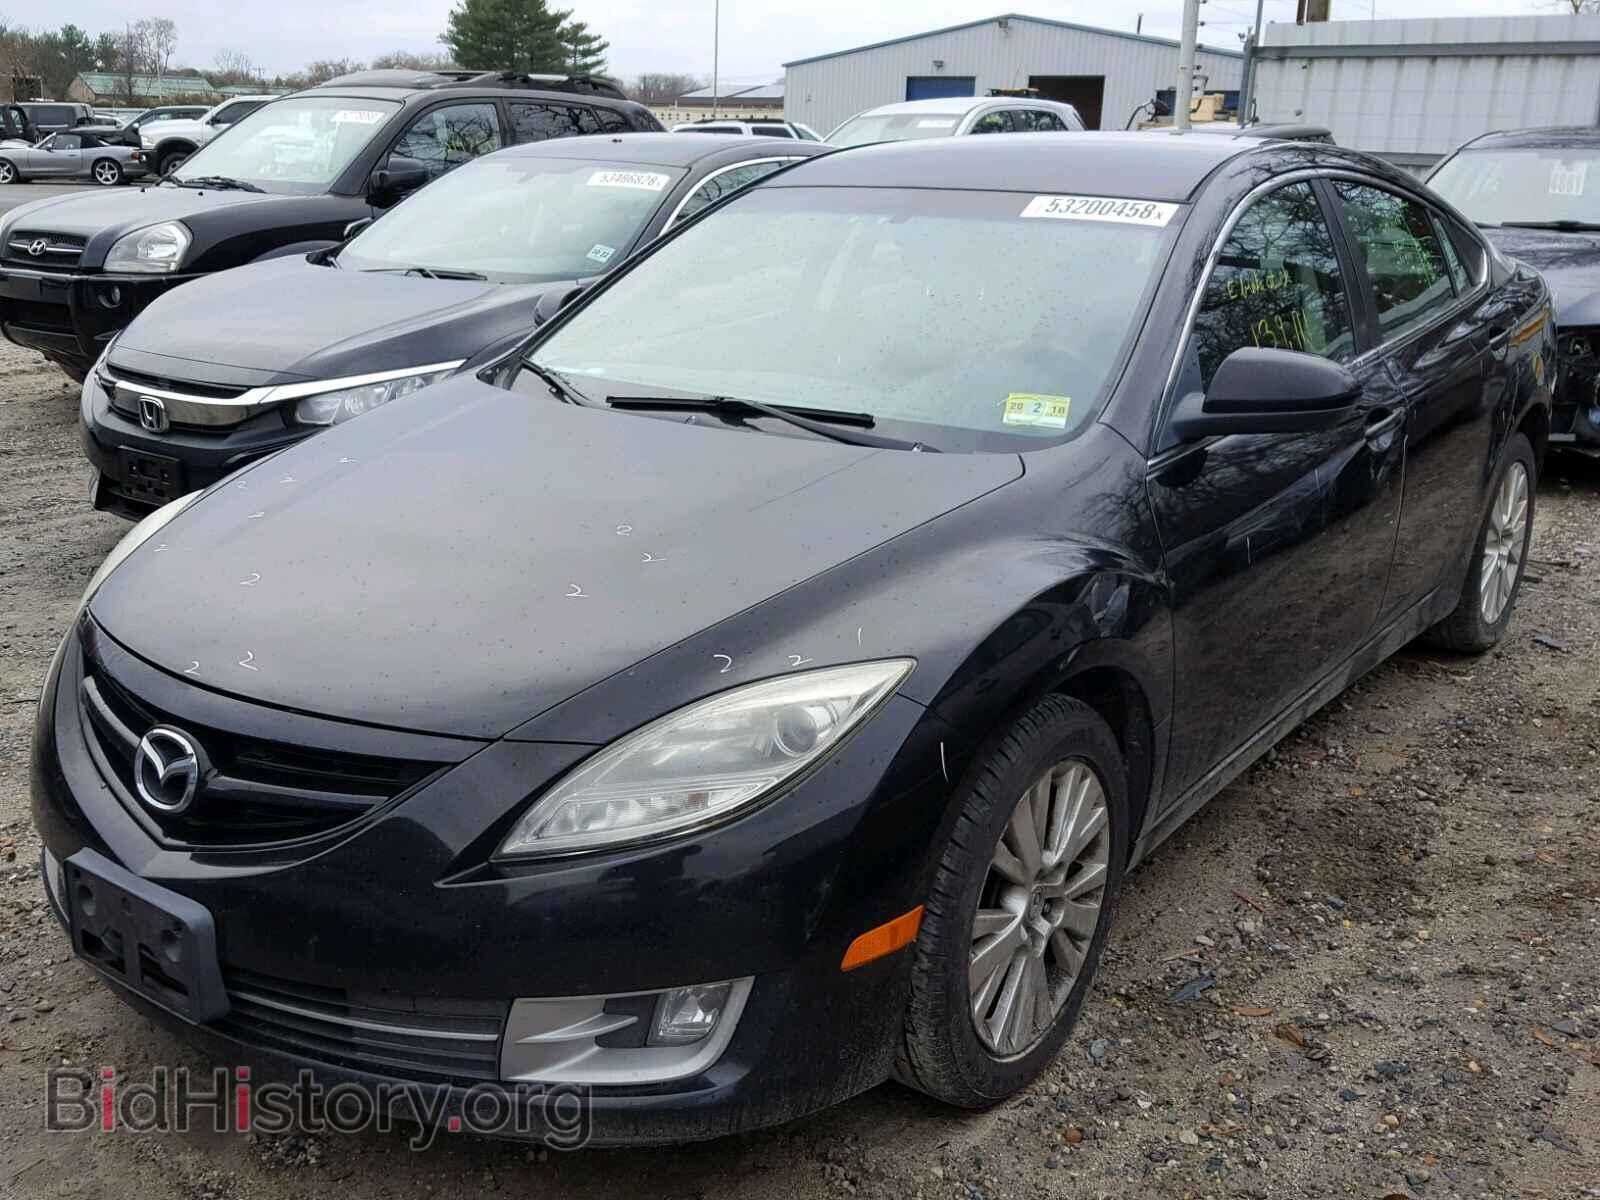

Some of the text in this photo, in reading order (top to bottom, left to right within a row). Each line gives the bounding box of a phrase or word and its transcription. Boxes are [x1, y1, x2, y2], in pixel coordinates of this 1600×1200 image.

[1033, 402, 1042, 413] 2
[564, 583, 590, 597] 2
[184, 660, 200, 676] 2
[239, 650, 258, 672] 2
